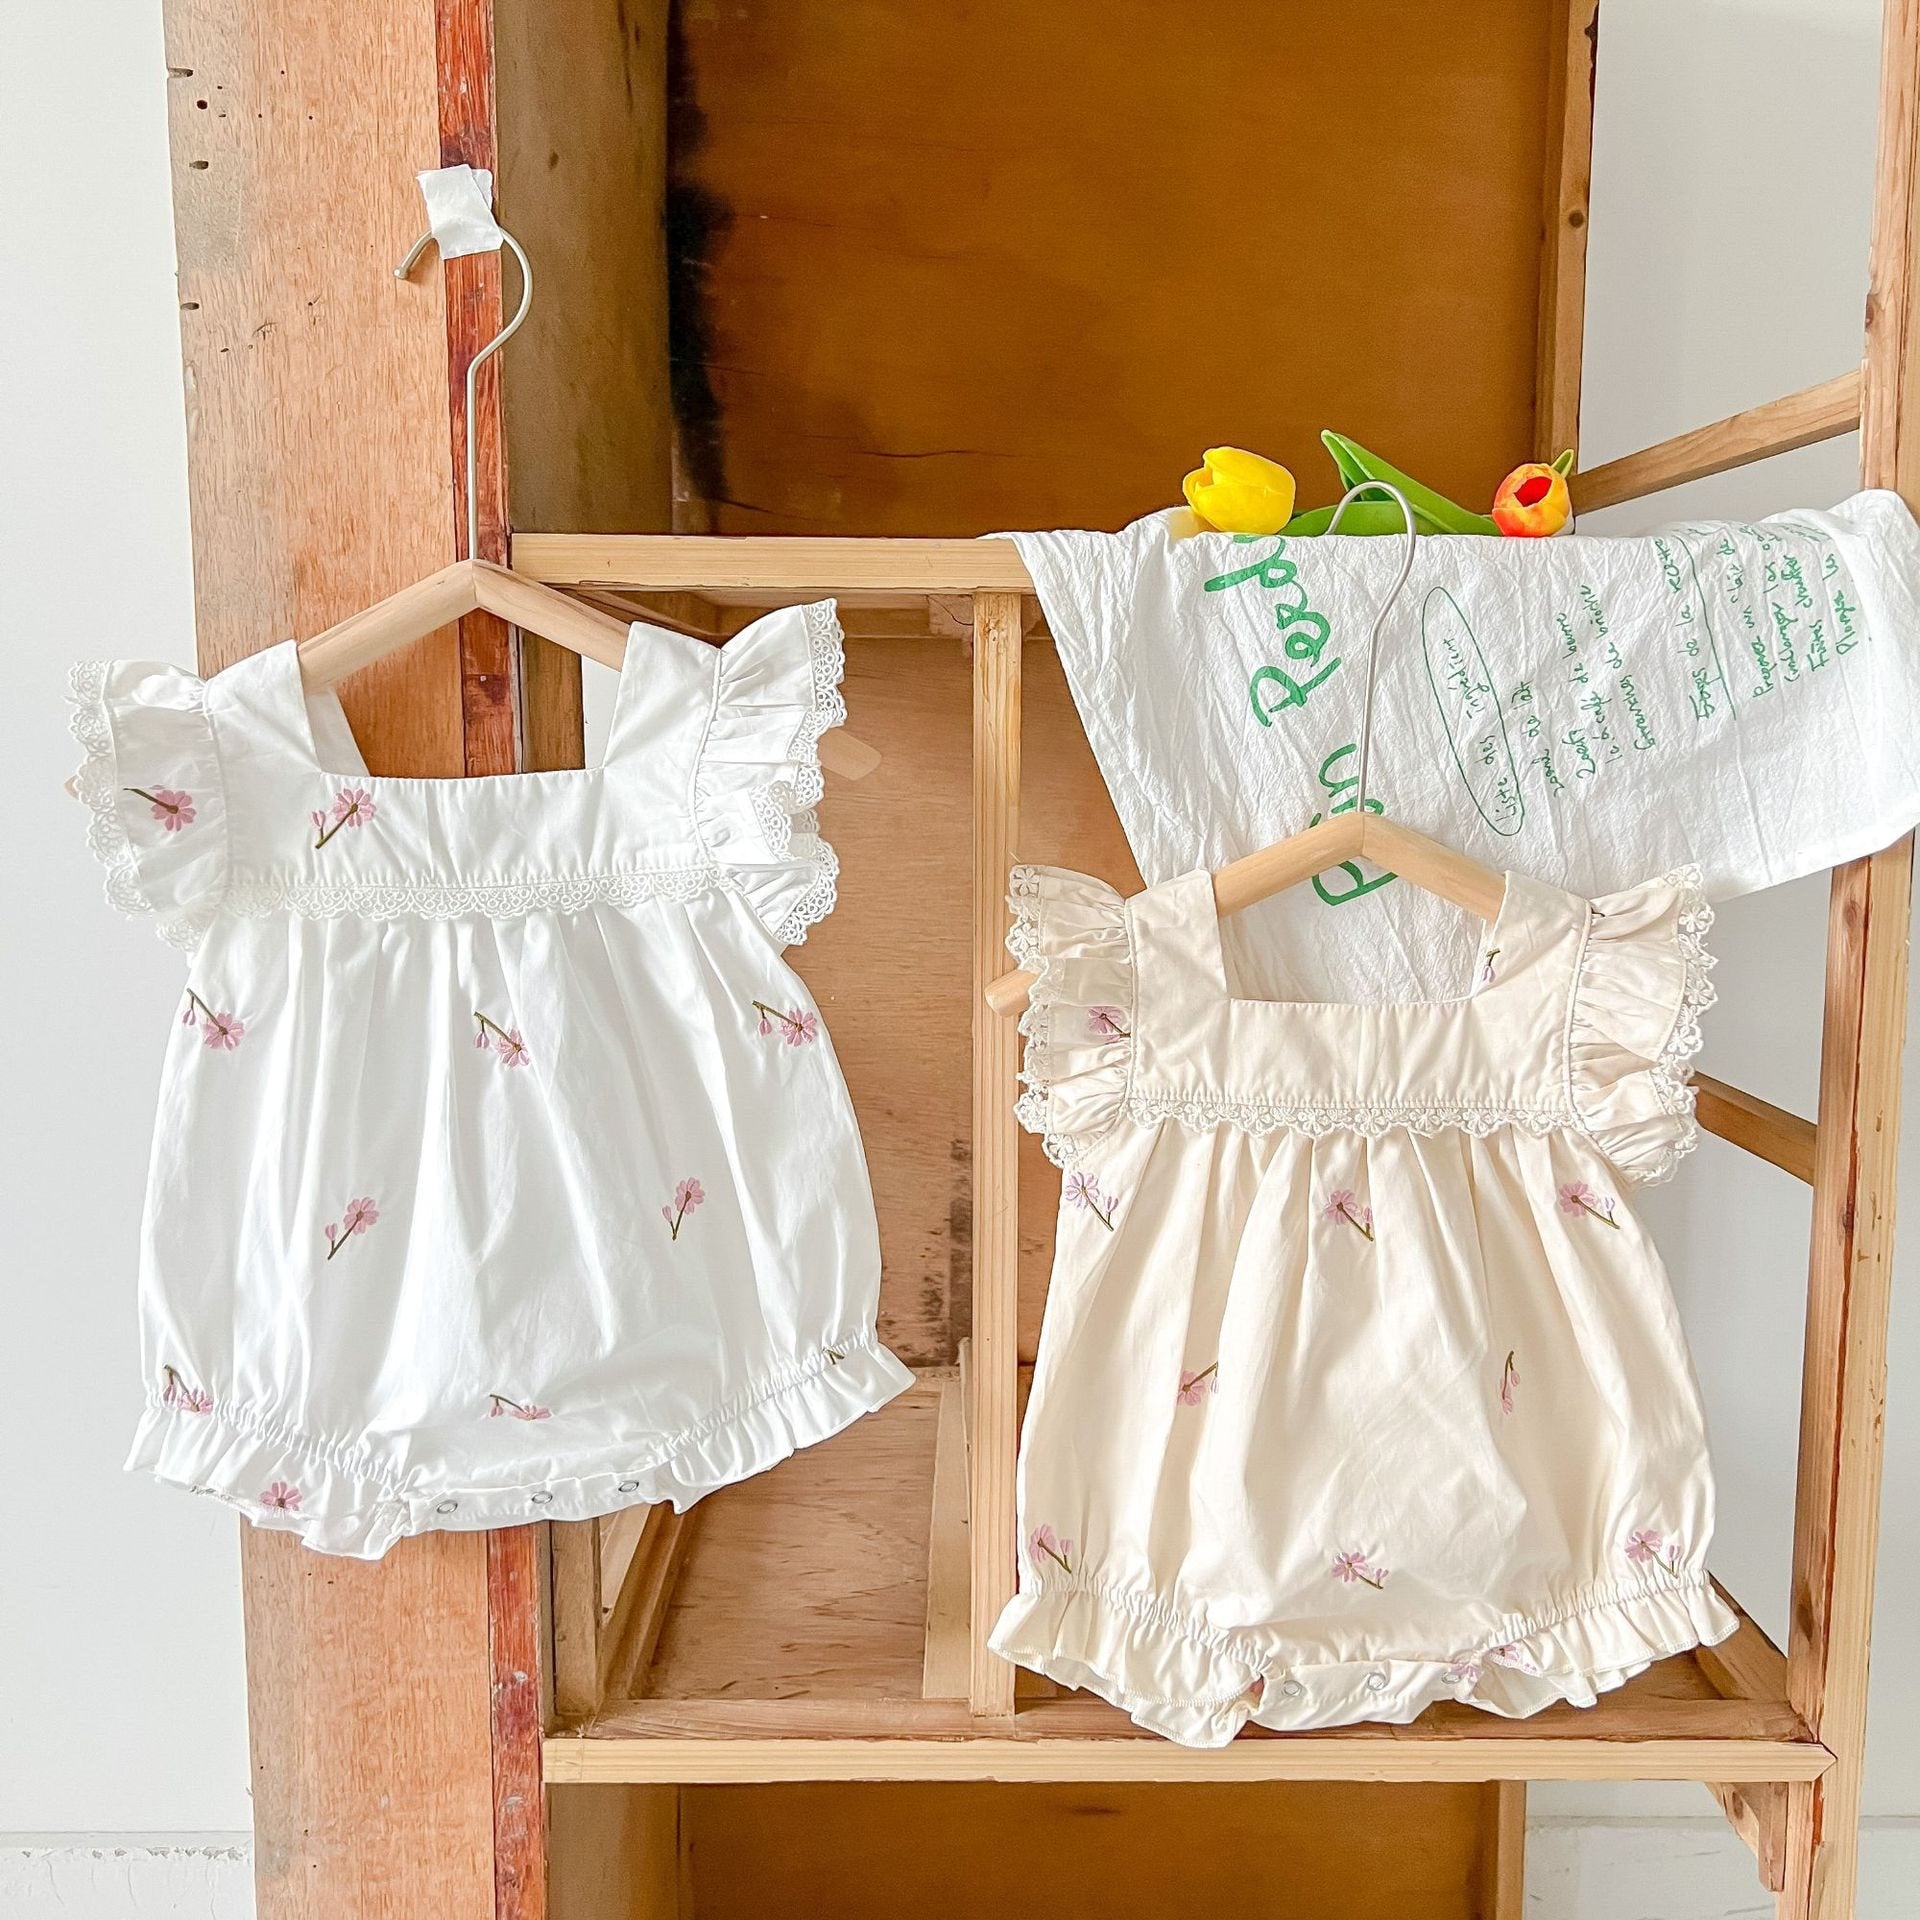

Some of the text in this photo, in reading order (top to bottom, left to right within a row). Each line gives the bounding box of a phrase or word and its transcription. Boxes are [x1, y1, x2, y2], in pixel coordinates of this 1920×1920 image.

[1675, 604, 1694, 627] la
[1605, 641, 1623, 669] de
[1677, 638, 1700, 657] de
[1568, 662, 1589, 684] de
[1521, 715, 1542, 737] de
[1474, 735, 1497, 765] des
